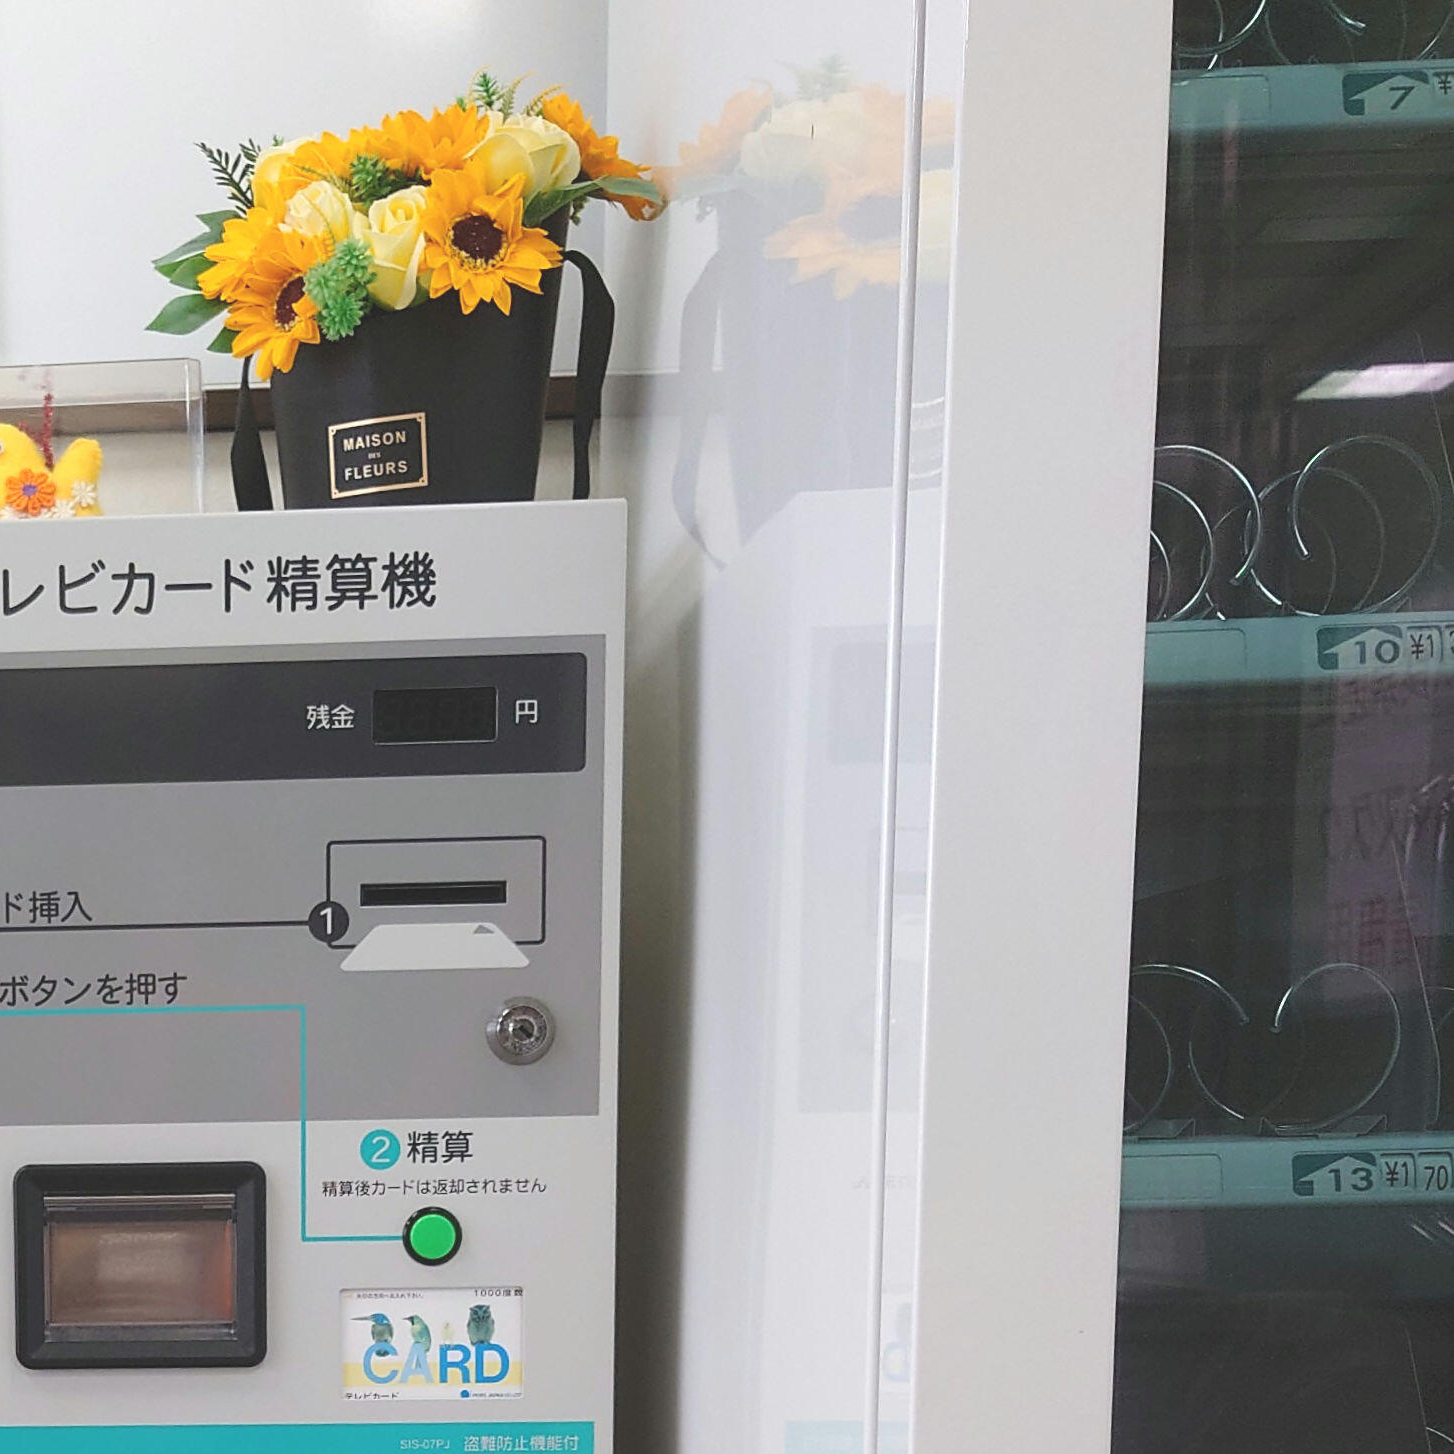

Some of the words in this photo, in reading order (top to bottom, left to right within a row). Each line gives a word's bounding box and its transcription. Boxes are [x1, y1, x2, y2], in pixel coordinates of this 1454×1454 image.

[1389, 86, 1416, 110] 7
[343, 430, 406, 452] MAISON
[344, 460, 408, 481] FLEURS
[1354, 639, 1400, 665] 10
[306, 704, 355, 730] 残金
[515, 699, 538, 724] 円
[407, 1130, 474, 1164] 精算
[322, 1178, 547, 1197] 精算後カードは返却されません
[1328, 1167, 1374, 1192] 13
[363, 1341, 510, 1384] CARD
[400, 1439, 450, 1450] SIS-07PJ
[464, 1435, 579, 1452] 盗難防止機能付
